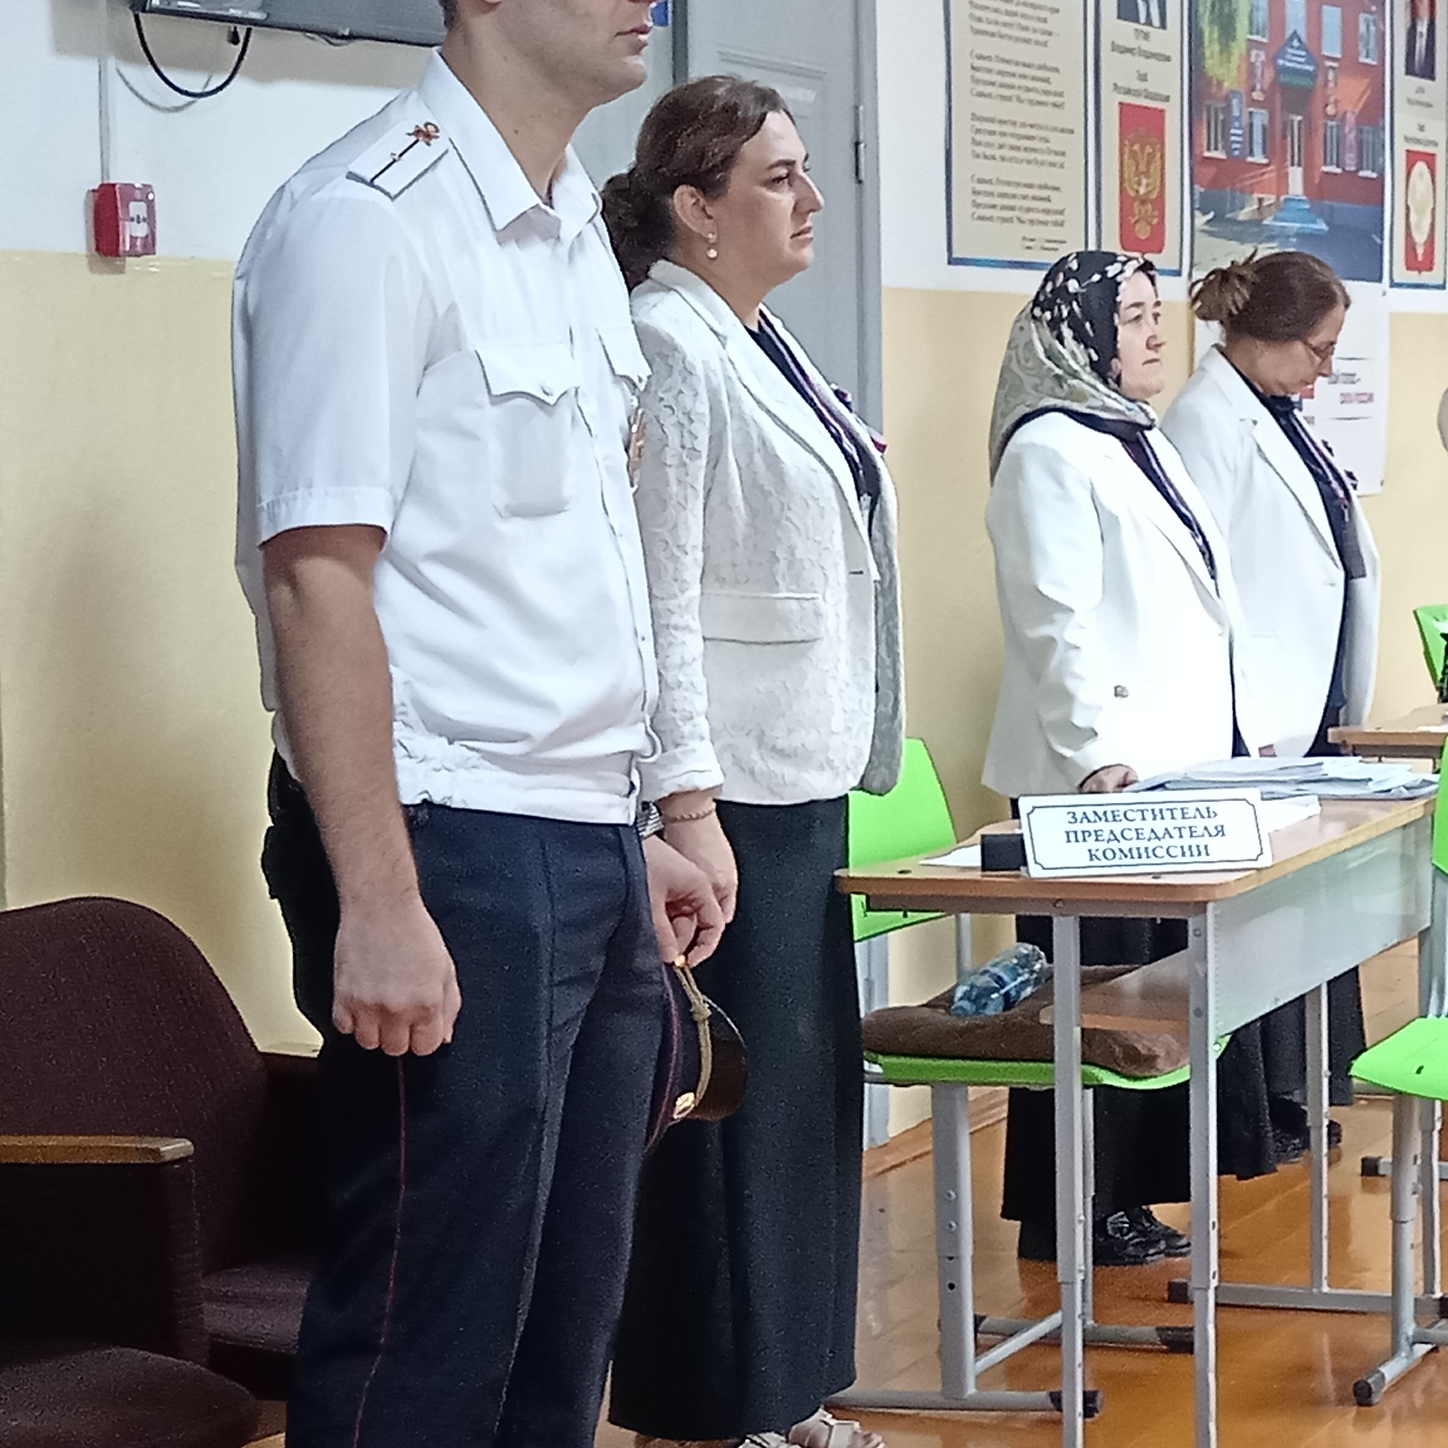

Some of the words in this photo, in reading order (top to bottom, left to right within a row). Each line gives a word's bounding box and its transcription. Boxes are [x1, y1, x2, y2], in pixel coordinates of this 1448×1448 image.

[1066, 806, 1218, 825] ЗАМЕСТИТЕЛЬ
[1064, 824, 1226, 844] ПРЕДСЕДАТЕЛЯ
[1087, 844, 1211, 862] КОМИССИИ
